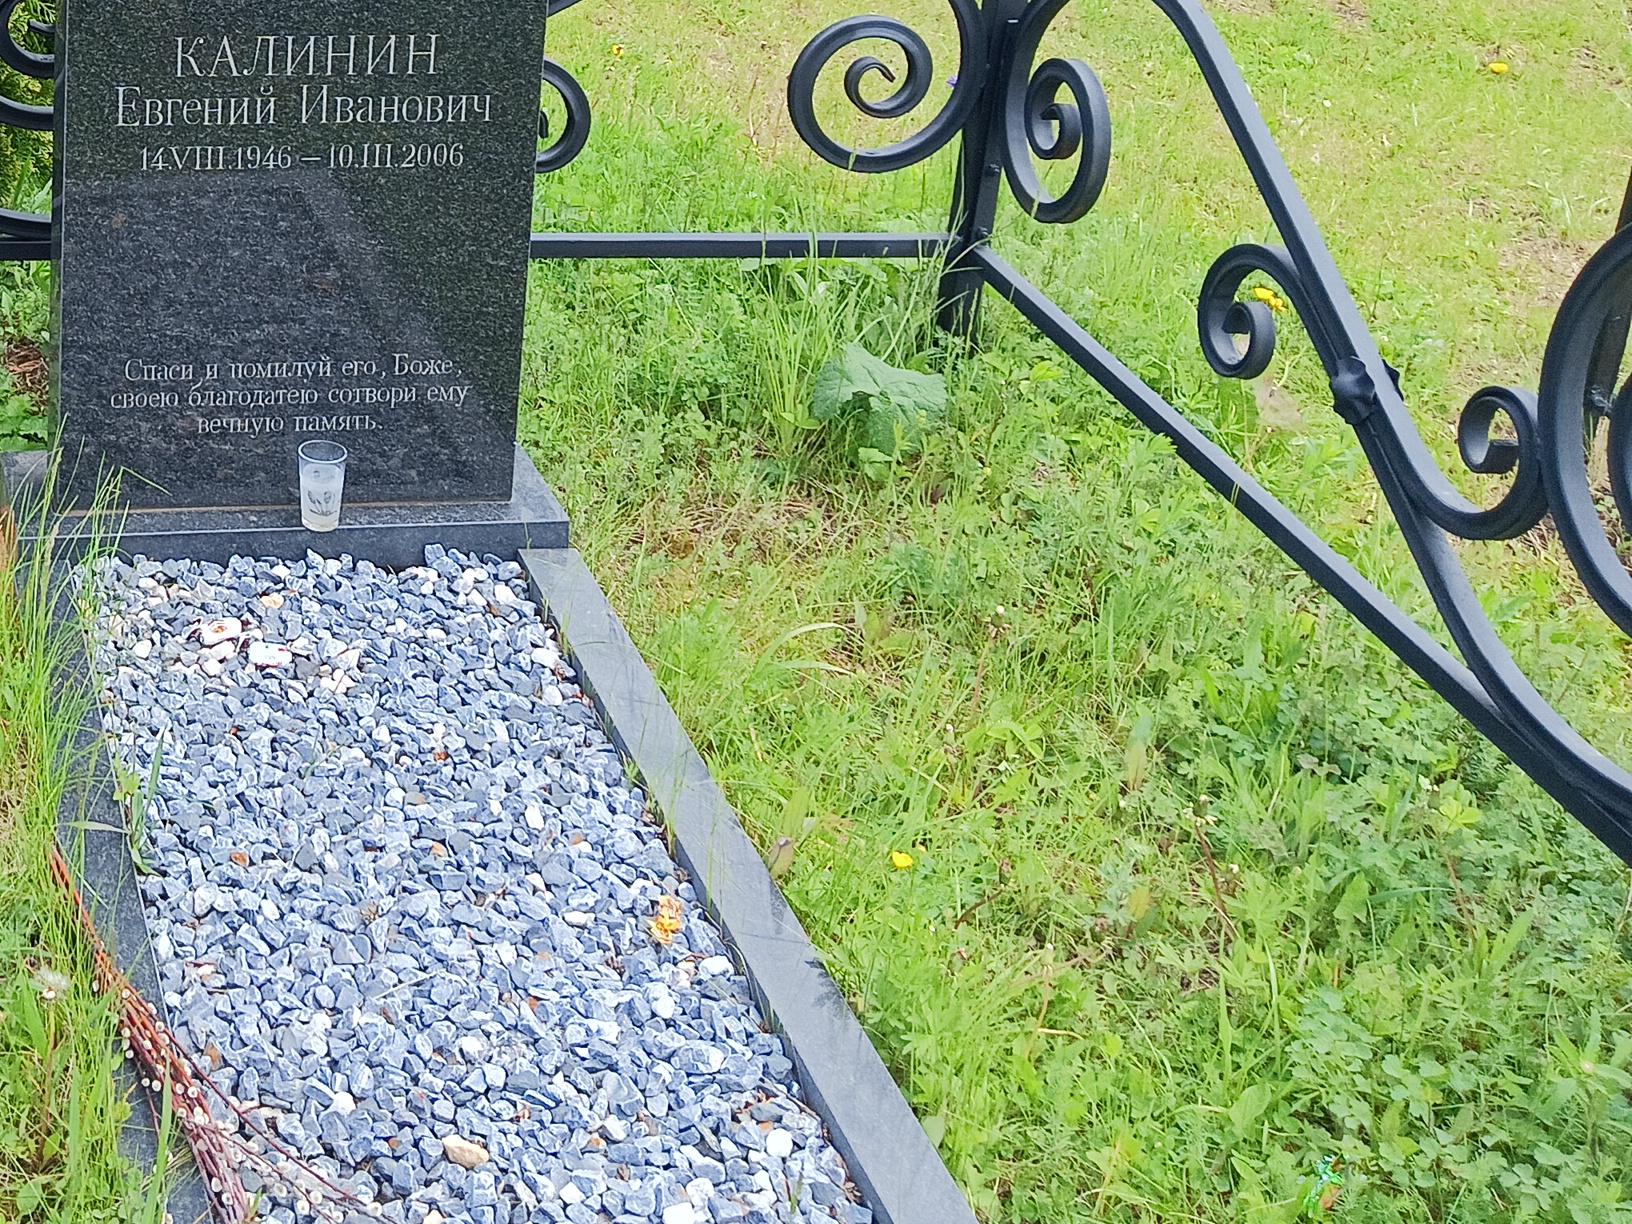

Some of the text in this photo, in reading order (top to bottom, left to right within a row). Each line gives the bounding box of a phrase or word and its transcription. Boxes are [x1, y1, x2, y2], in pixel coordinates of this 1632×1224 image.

[174, 34, 441, 77] КАЛИНИН
[115, 85, 495, 127] Евгений Иванович
[124, 353, 464, 384] Спаси и помилуй его, Боже,
[110, 377, 471, 410] своею благодатею сотвори ему
[197, 414, 384, 439] вечную память.
